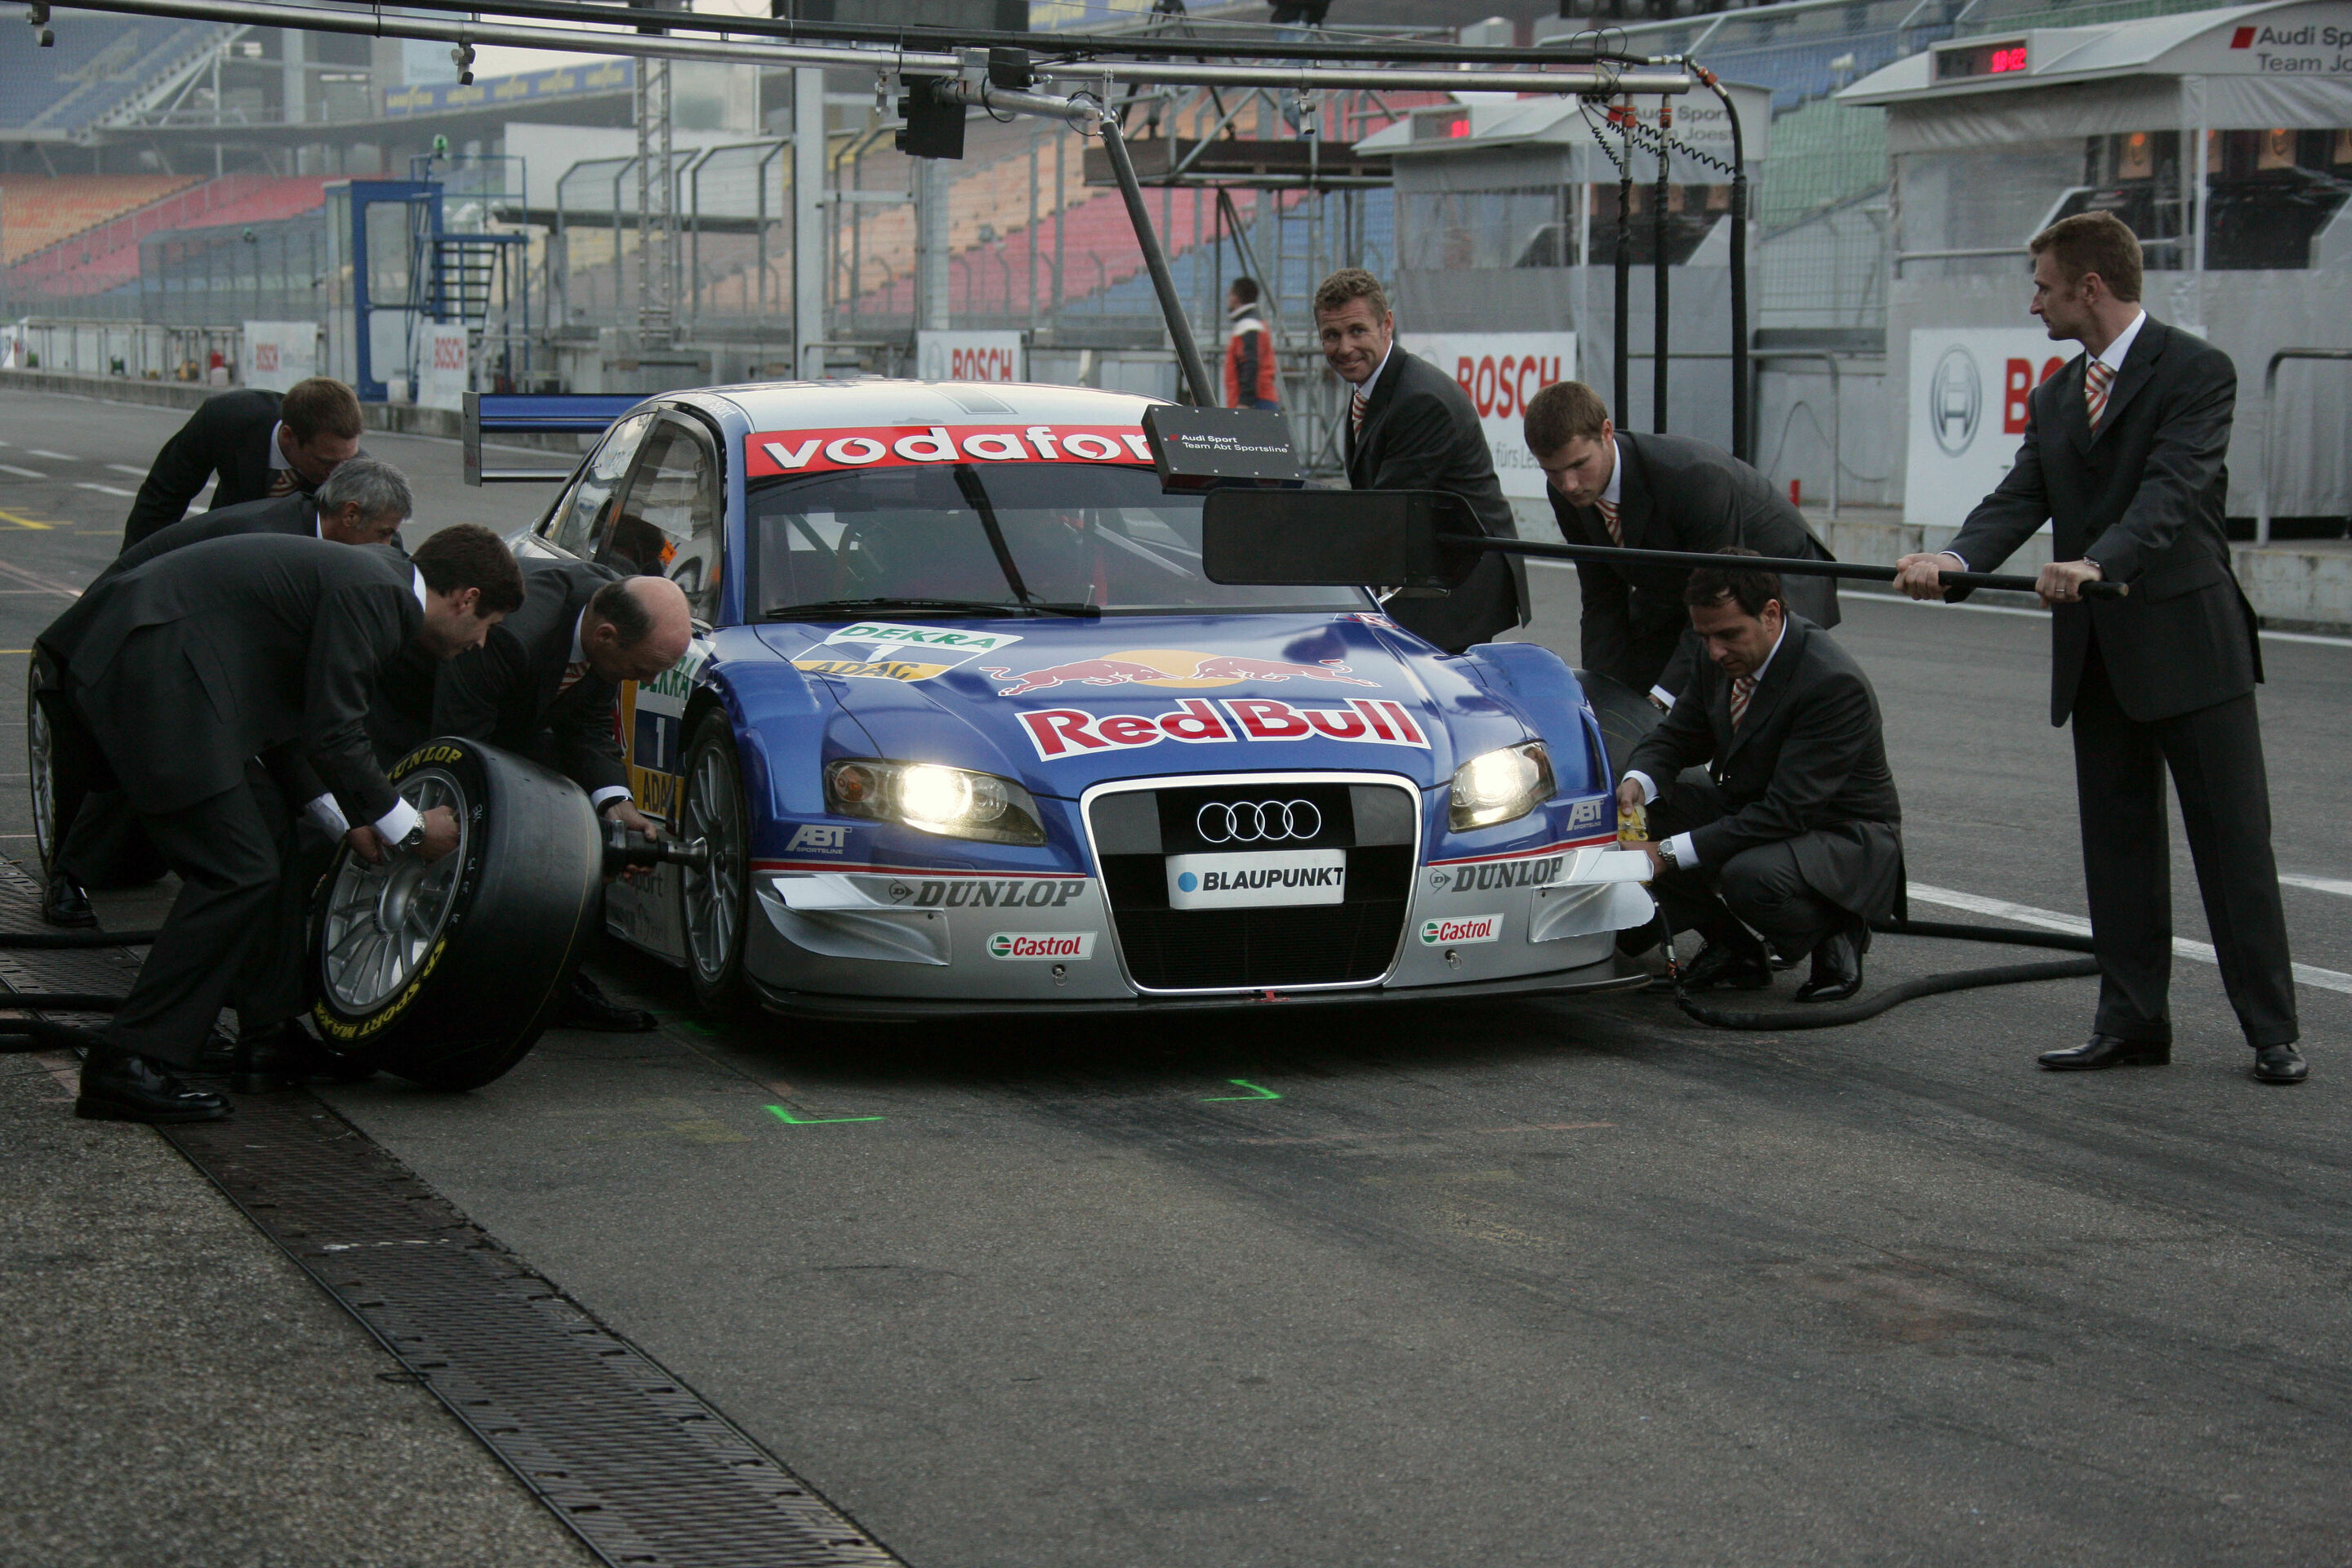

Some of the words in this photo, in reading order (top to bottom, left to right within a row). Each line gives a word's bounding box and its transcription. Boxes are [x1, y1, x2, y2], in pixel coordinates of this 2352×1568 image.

[2257, 26, 2316, 45] Audi
[2257, 53, 2323, 72] Team
[951, 347, 1013, 381] BOSCH
[1207, 435, 1237, 443] Sport
[1234, 444, 1288, 453] Sportsline
[835, 626, 998, 648] DEKRA
[865, 644, 905, 663] 1
[810, 662, 920, 679] ADAC
[656, 716, 666, 768] 1
[1015, 698, 1237, 762] Red
[1218, 698, 1431, 750] Bull
[386, 746, 464, 782] UNLOP
[1566, 801, 1604, 831] ABT
[784, 824, 847, 852] ABT
[796, 846, 844, 855] SPORTSLINE
[1202, 866, 1343, 892] BLAUPUNKT
[1451, 857, 1564, 892] DUNLOP
[913, 880, 1086, 908] DUNLOP
[1439, 919, 1492, 942] Castrol
[422, 938, 448, 978] SP
[1013, 935, 1080, 956] Castrol
[357, 979, 422, 1038] SPORT
